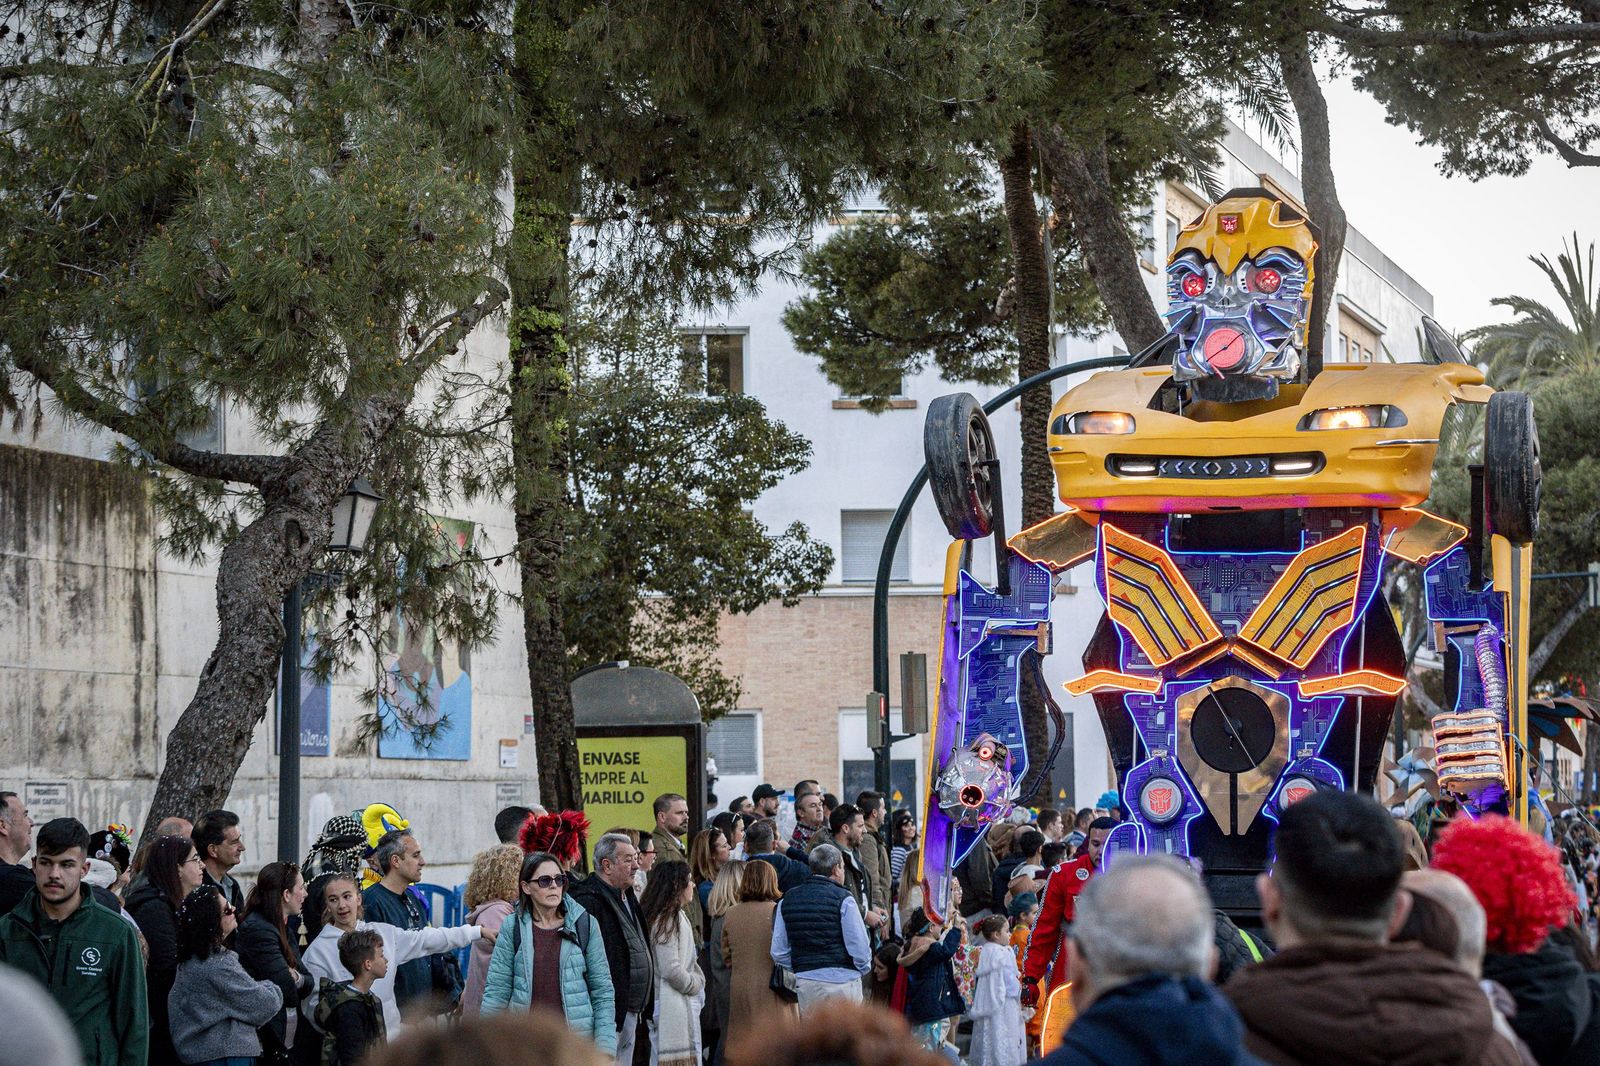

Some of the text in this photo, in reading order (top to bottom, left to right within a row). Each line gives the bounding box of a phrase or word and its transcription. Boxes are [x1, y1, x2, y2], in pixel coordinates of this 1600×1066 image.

[583, 752, 640, 766] ENVASE
[580, 771, 648, 785] EMPRE AL
[582, 791, 645, 804] MARILLO
